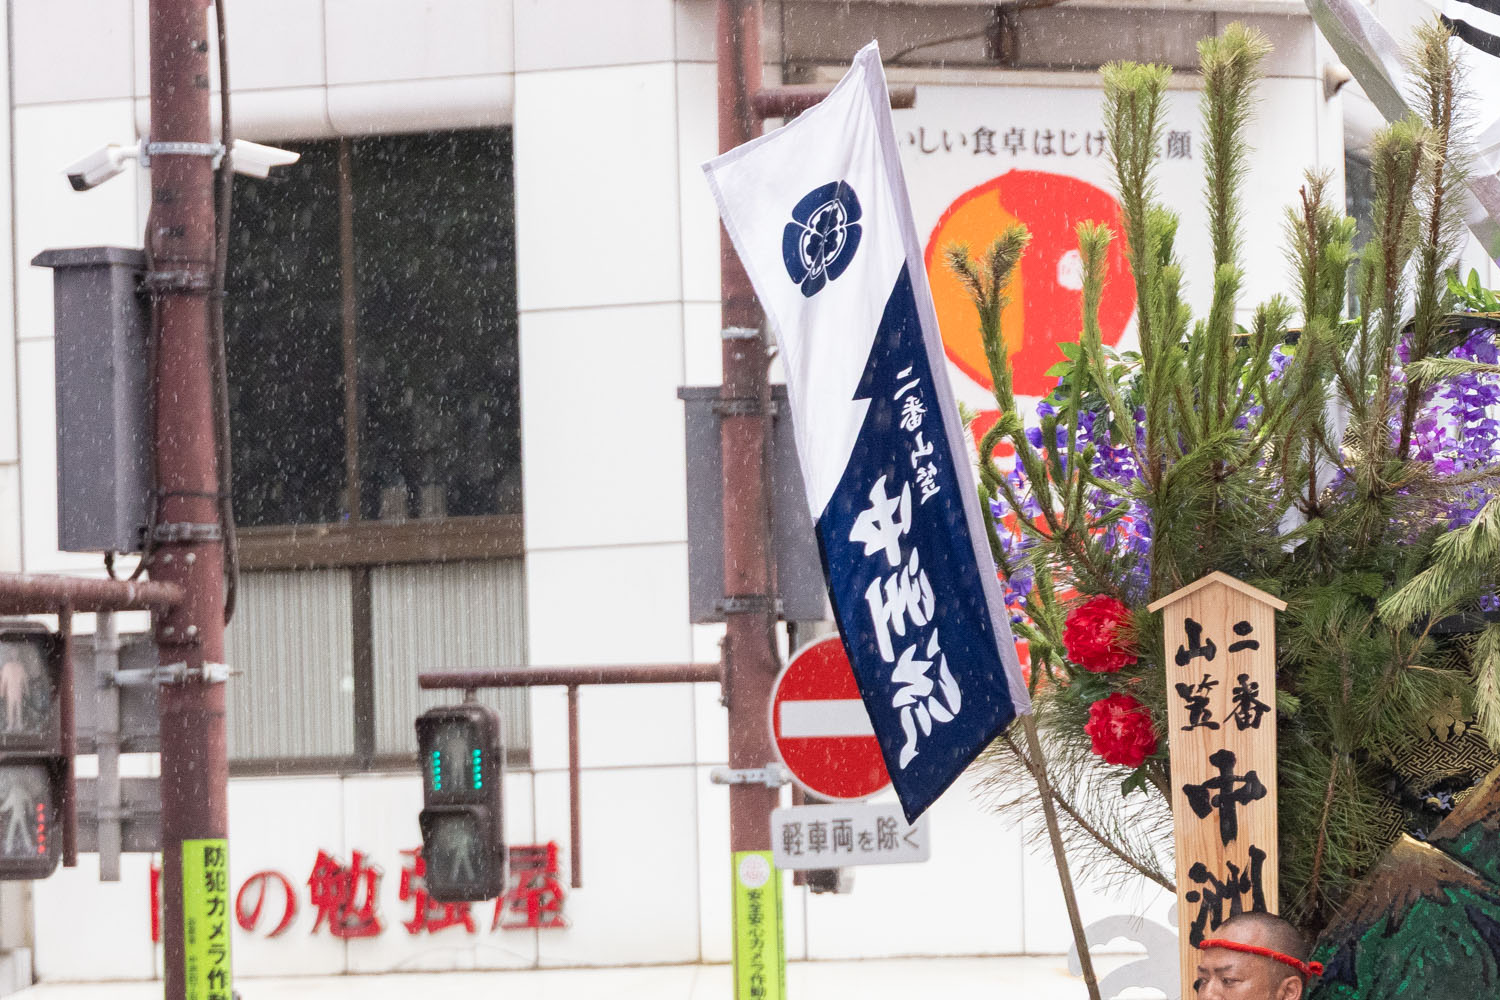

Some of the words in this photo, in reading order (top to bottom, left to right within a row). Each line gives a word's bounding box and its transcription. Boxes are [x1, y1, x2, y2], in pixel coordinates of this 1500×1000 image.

[907, 126, 1193, 160] しい食卓はじけ顔
[893, 366, 941, 505] 二番山笠
[782, 816, 920, 856] 軽車両を除く
[150, 840, 570, 940] の勉強屋
